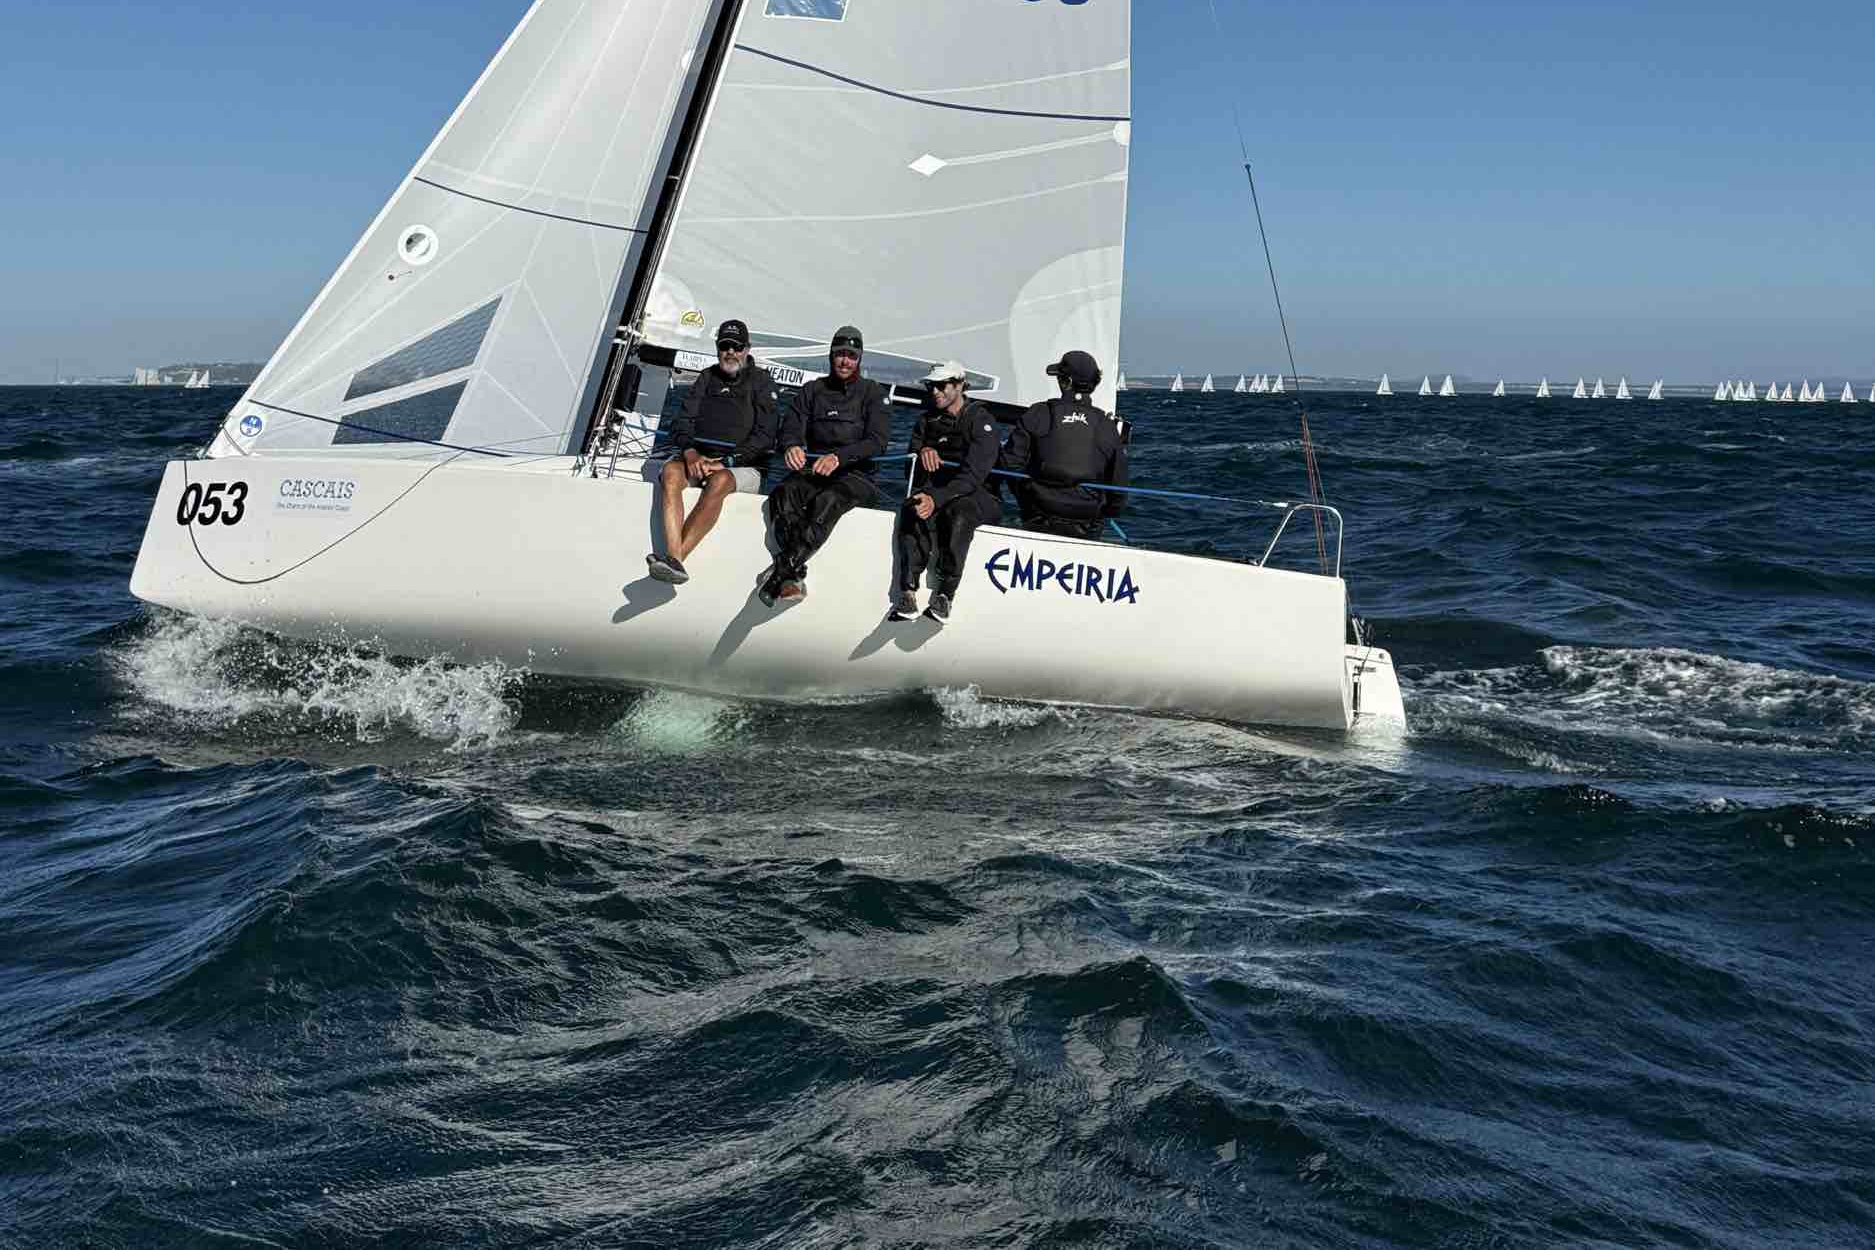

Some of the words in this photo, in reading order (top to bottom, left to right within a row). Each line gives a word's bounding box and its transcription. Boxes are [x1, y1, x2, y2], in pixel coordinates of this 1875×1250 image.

[176, 481, 248, 526] 053
[280, 479, 354, 499] CASCAIS
[985, 548, 1139, 604] EMPEIRIA
